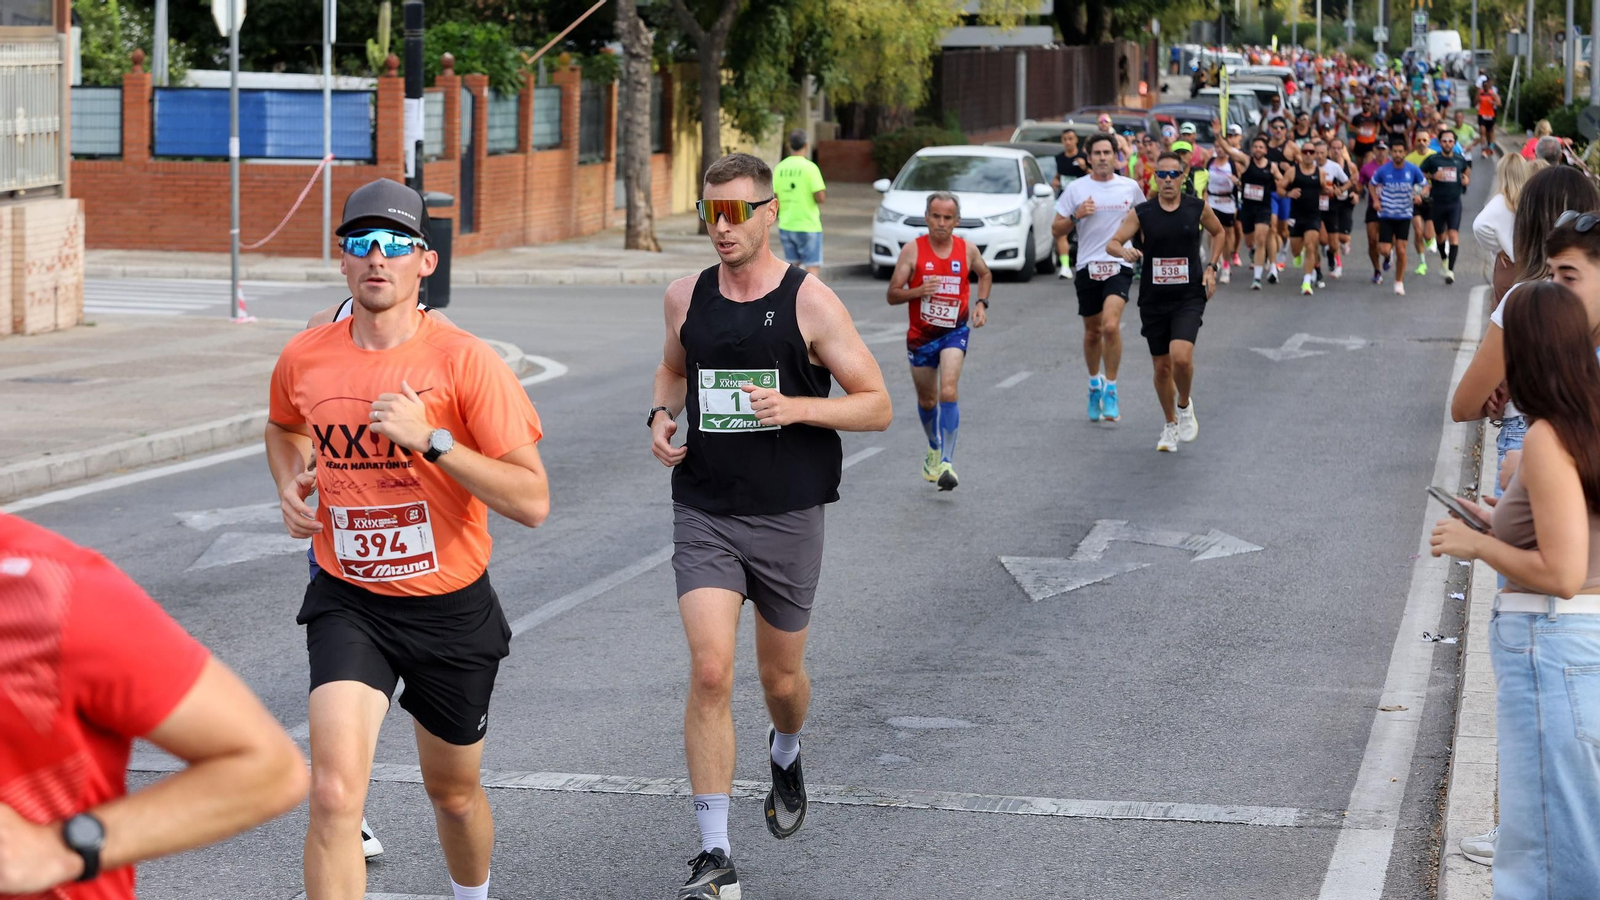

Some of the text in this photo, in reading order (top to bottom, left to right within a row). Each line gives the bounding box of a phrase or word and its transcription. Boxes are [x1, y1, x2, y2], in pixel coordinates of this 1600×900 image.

[1096, 265, 1114, 273] 302
[1161, 267, 1180, 275] 538
[929, 305, 950, 317] 532
[731, 391, 741, 412] 1
[726, 418, 769, 429] MIZU
[350, 459, 399, 470] MARATÓN
[353, 530, 409, 558] 394
[371, 559, 430, 577] MIZUNO
